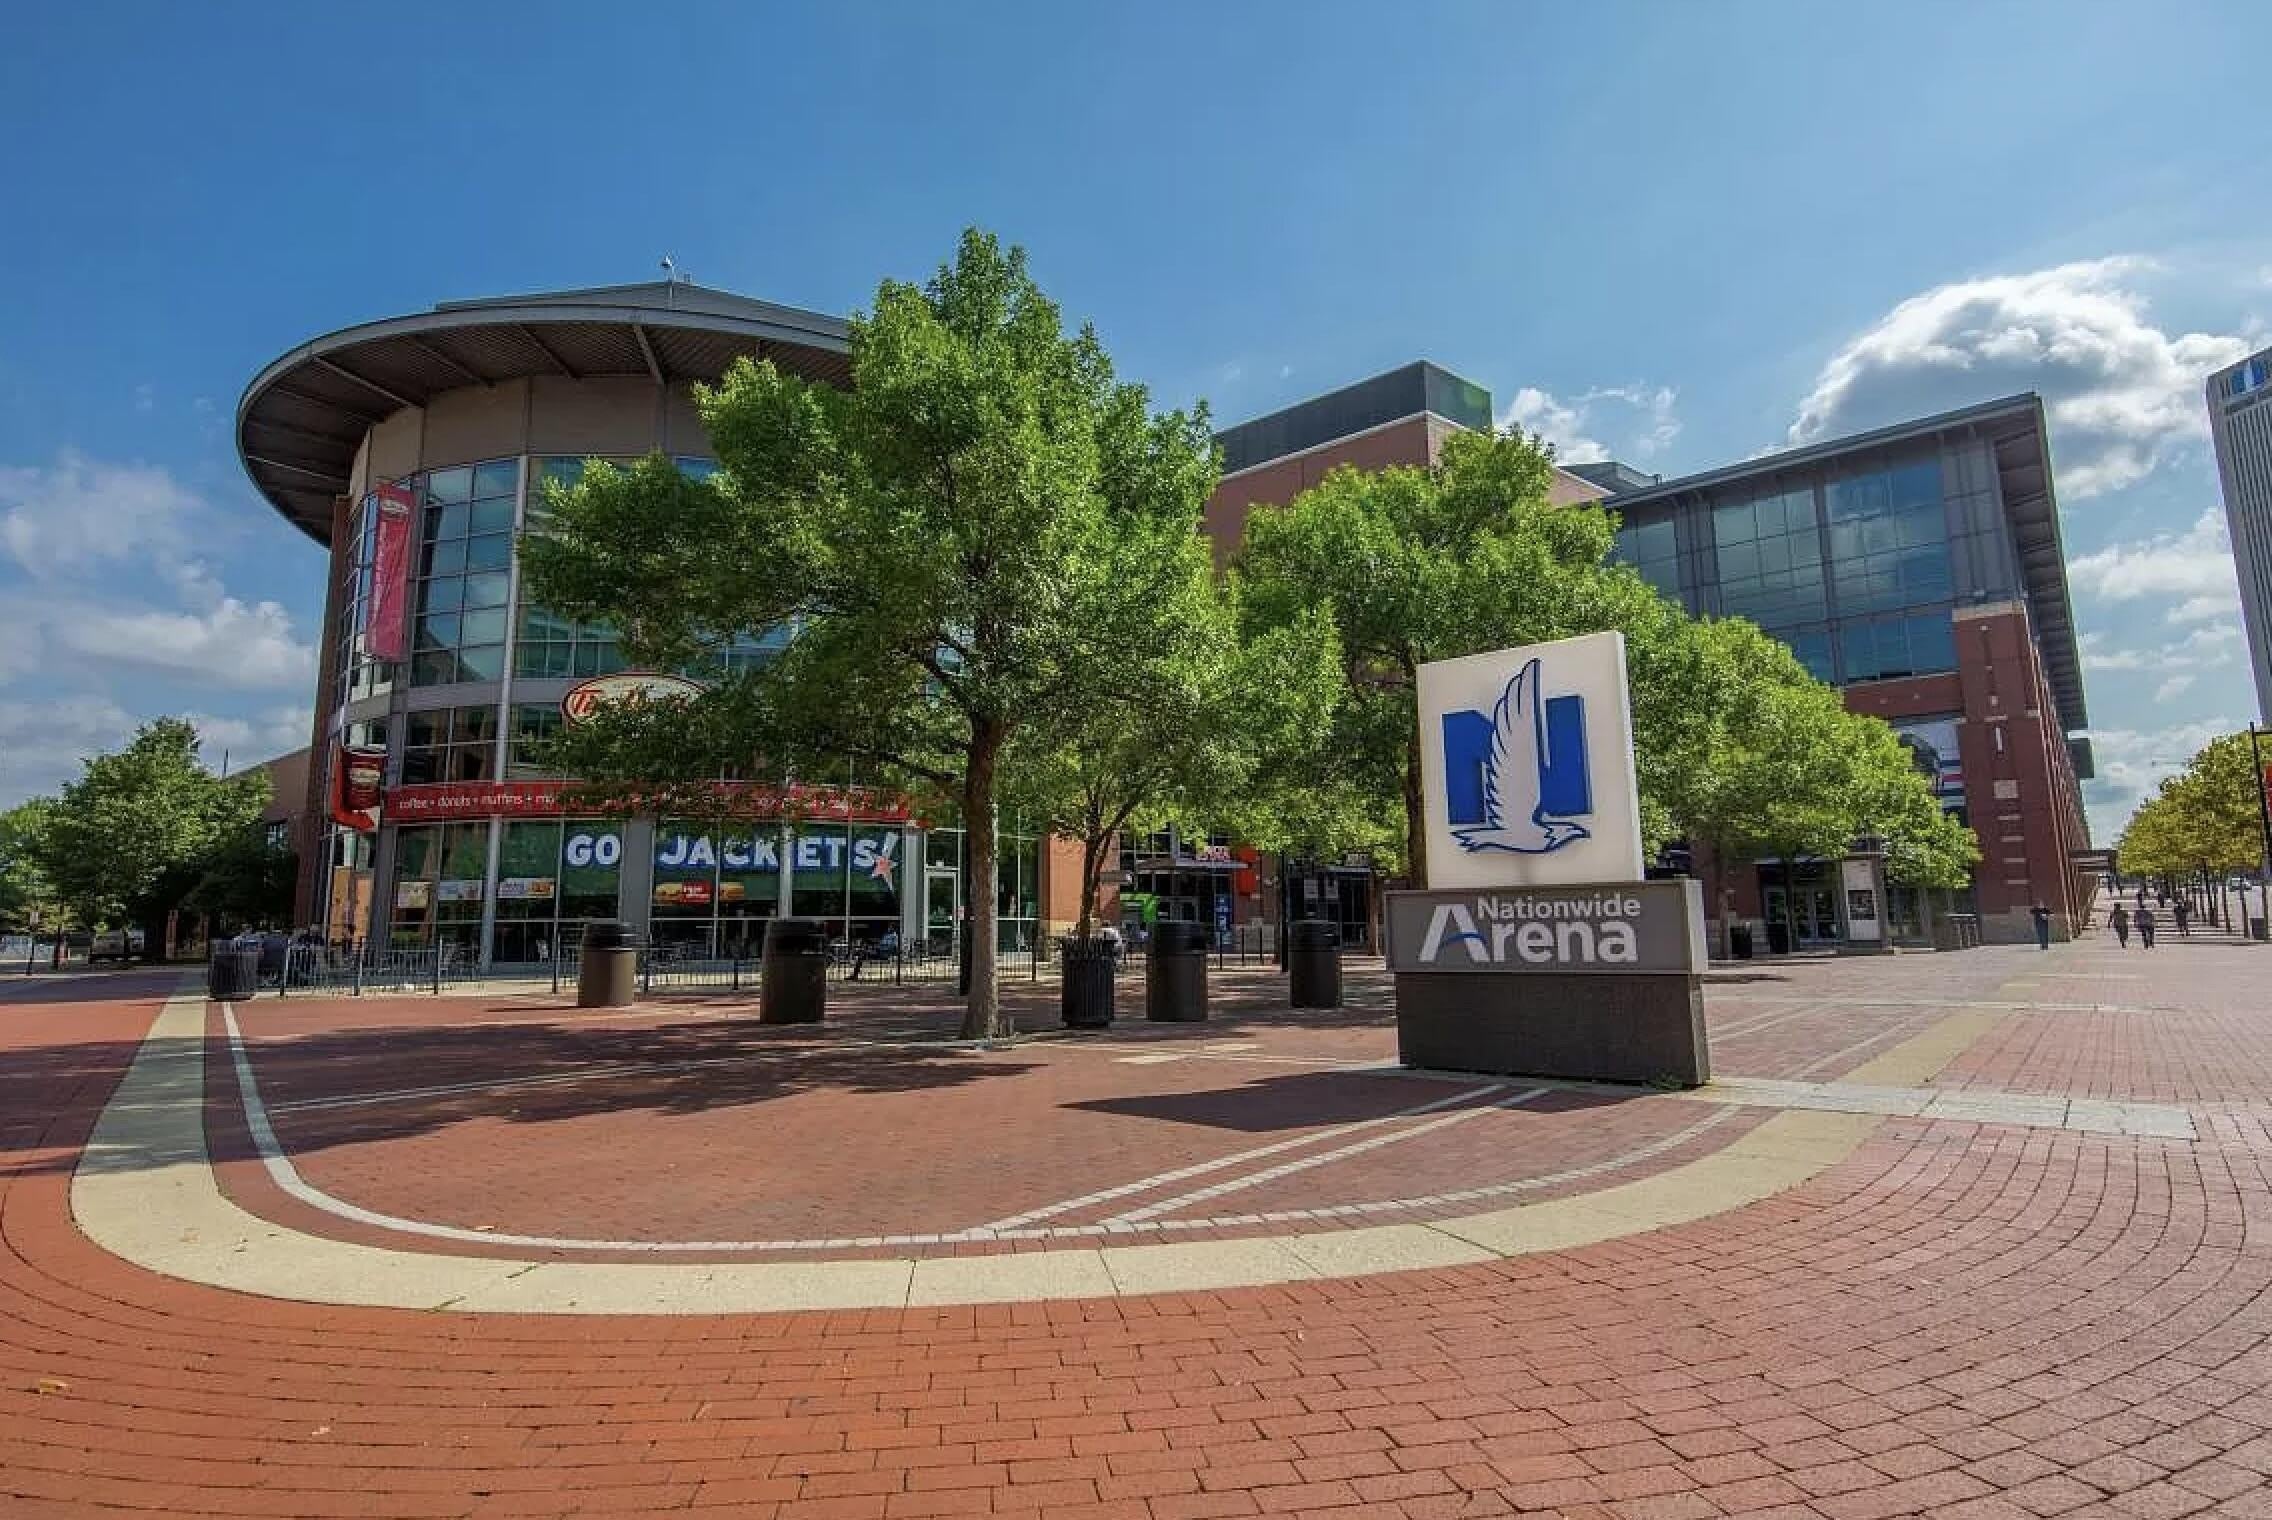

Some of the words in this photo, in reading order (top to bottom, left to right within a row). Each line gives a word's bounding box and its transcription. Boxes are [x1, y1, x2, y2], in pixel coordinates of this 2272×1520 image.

[567, 835, 621, 866] GO
[659, 831, 899, 876] JACKETS!
[1477, 893, 1641, 920] Nationwide
[1418, 903, 1639, 963] Arena
